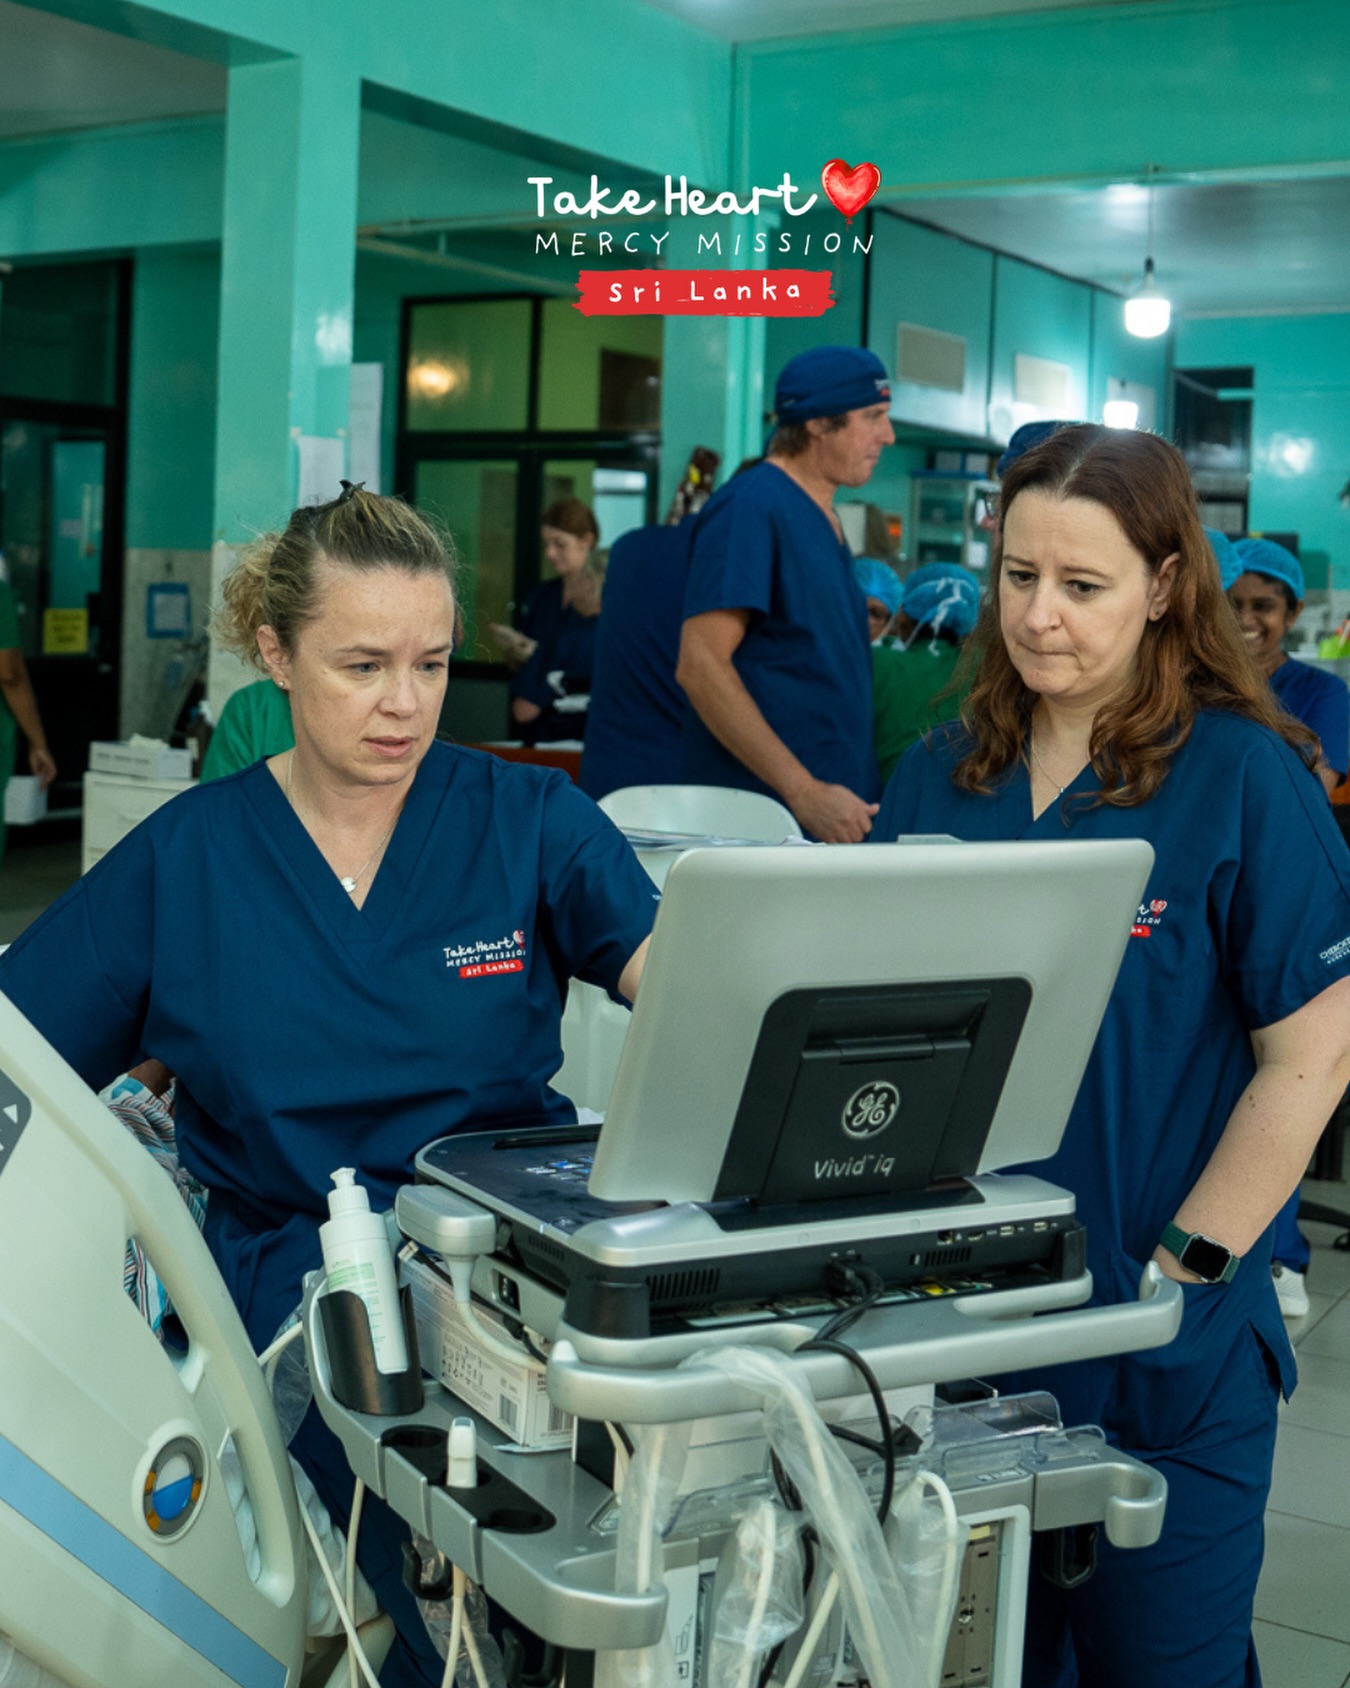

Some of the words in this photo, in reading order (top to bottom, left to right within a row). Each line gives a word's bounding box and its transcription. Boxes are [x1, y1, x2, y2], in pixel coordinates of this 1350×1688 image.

[443, 945, 476, 959] Take
[476, 937, 514, 952] Heart
[447, 956, 481, 967] MERCY
[466, 967, 481, 976] Sri
[486, 961, 515, 972] Lanka
